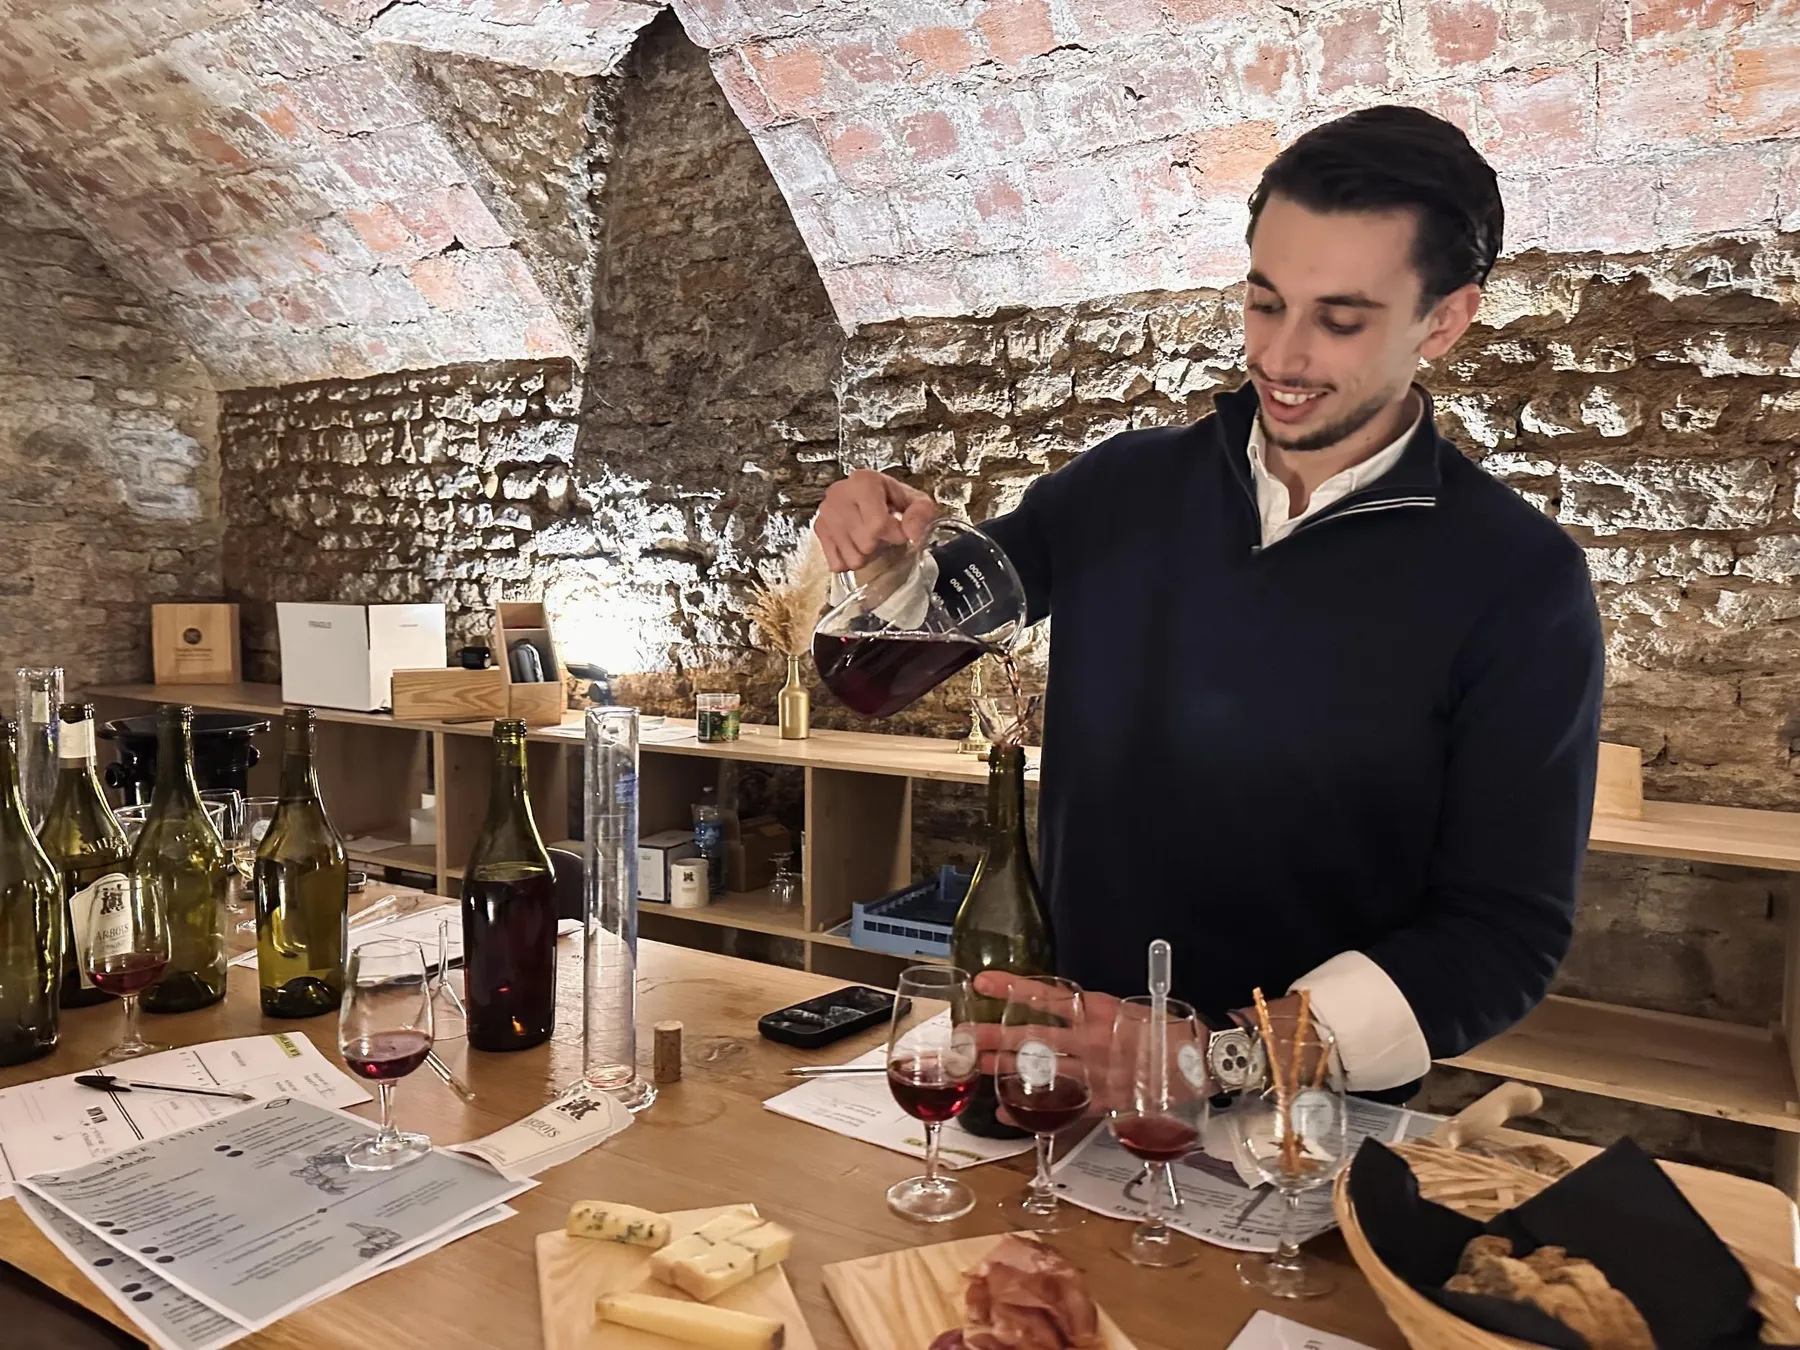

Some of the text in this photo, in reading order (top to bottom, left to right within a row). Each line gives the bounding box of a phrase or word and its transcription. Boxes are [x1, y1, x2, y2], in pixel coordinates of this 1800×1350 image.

[95, 923, 129, 941] ARBOIS
[99, 1146, 147, 1166] WINE
[157, 1120, 228, 1146] TASTING
